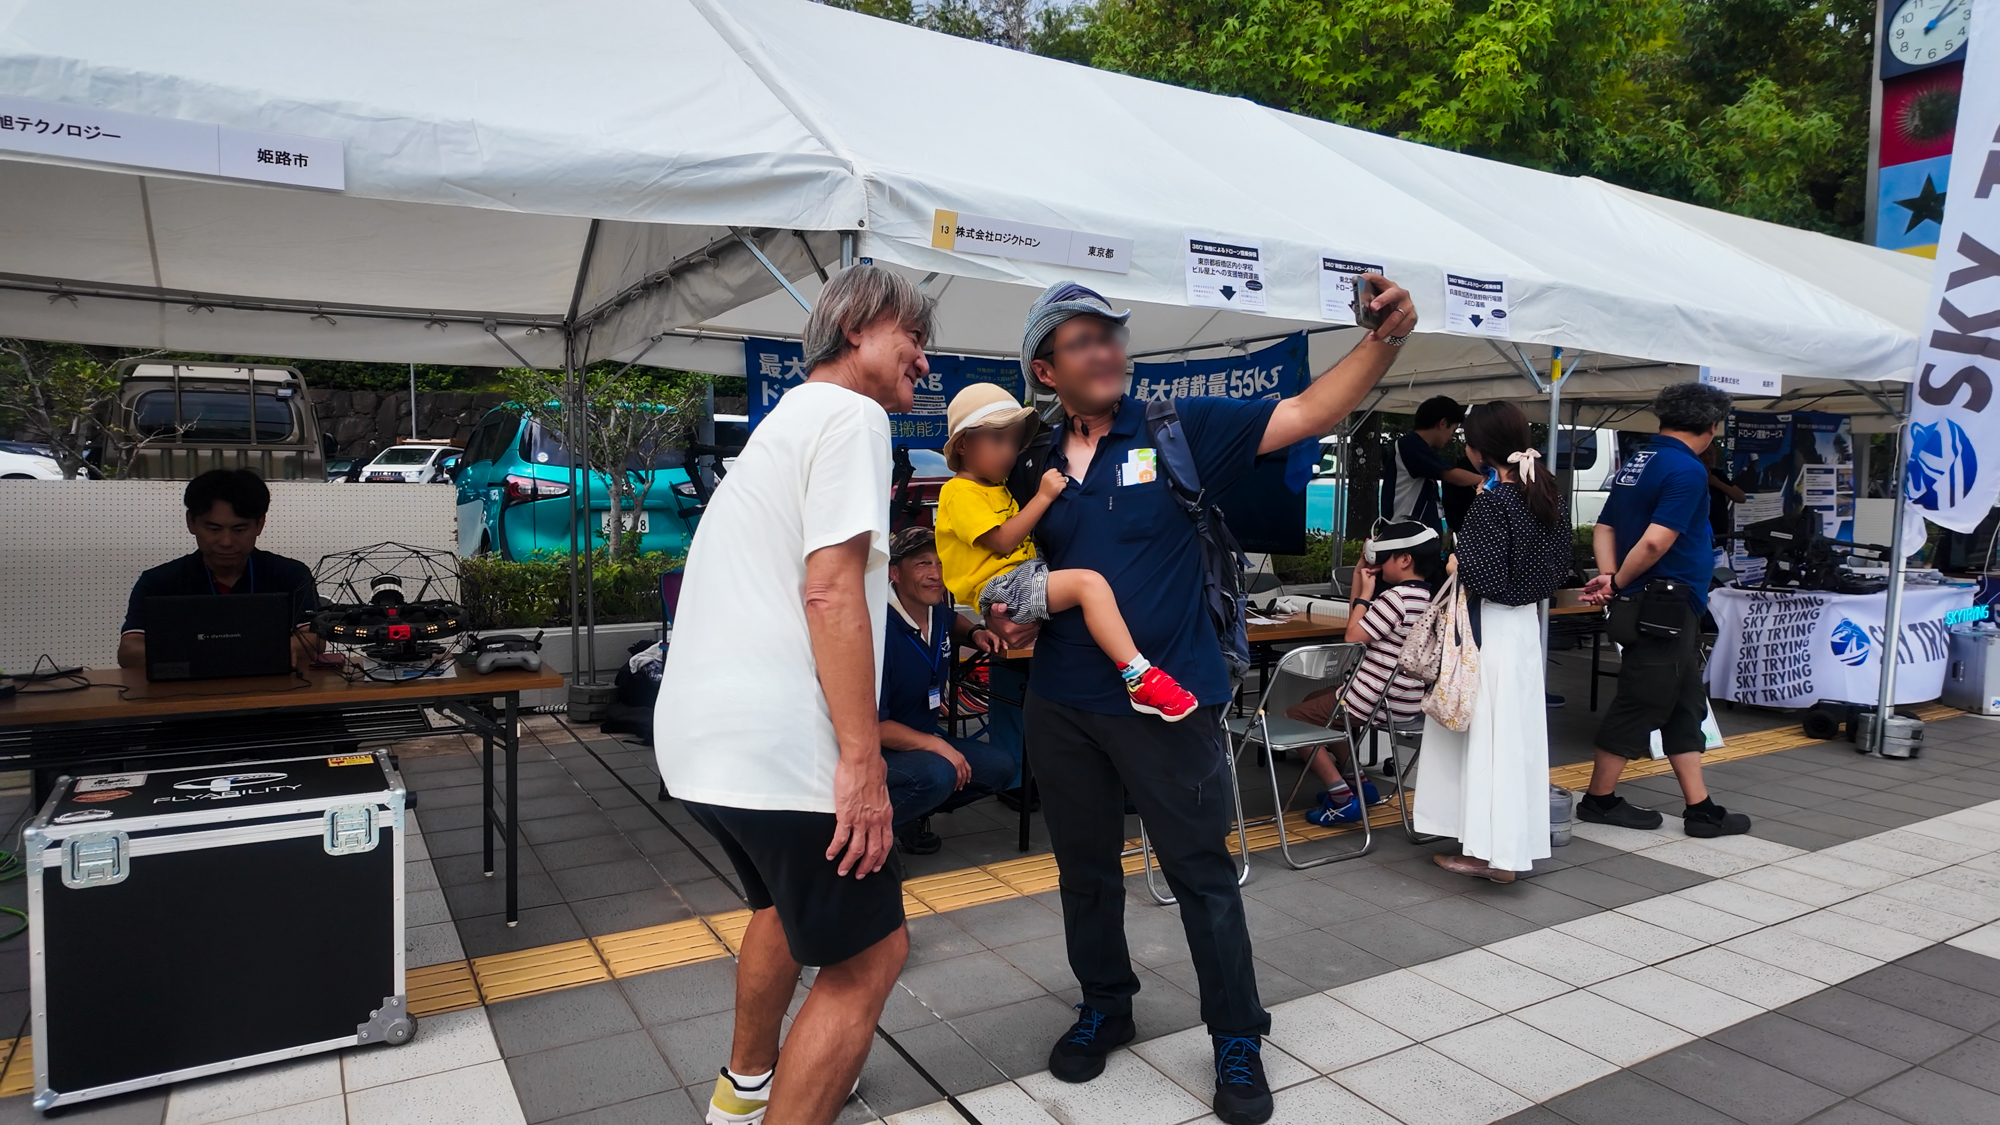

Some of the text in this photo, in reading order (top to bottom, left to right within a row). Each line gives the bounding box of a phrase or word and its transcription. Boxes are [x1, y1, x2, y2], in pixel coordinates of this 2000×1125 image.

[1900, 12, 1914, 24] 10
[1963, 9, 1972, 21] 3
[1896, 28, 1905, 39] 9
[1957, 26, 1966, 36] 4
[1900, 41, 1909, 52] 8
[1914, 48, 1922, 59] 7
[1928, 48, 1937, 59] 6
[1944, 39, 1953, 51] 5
[256, 148, 309, 168] 姫路市
[940, 225, 1115, 259] 13 株式会社ロジクトロン 東京都
[759, 353, 808, 381] 最大
[1748, 596, 1824, 616] SKY TRYING
[1743, 608, 1820, 629] SKY TRYING
[1742, 622, 1816, 645] SKY TRYING
[1739, 636, 1810, 660] SKY TRYING
[1737, 649, 1811, 675] SKY TRYING
[1736, 664, 1812, 689] SKY TRYING
[1734, 680, 1814, 704] SKY TRYING
[153, 784, 302, 804] FLYABILITY
